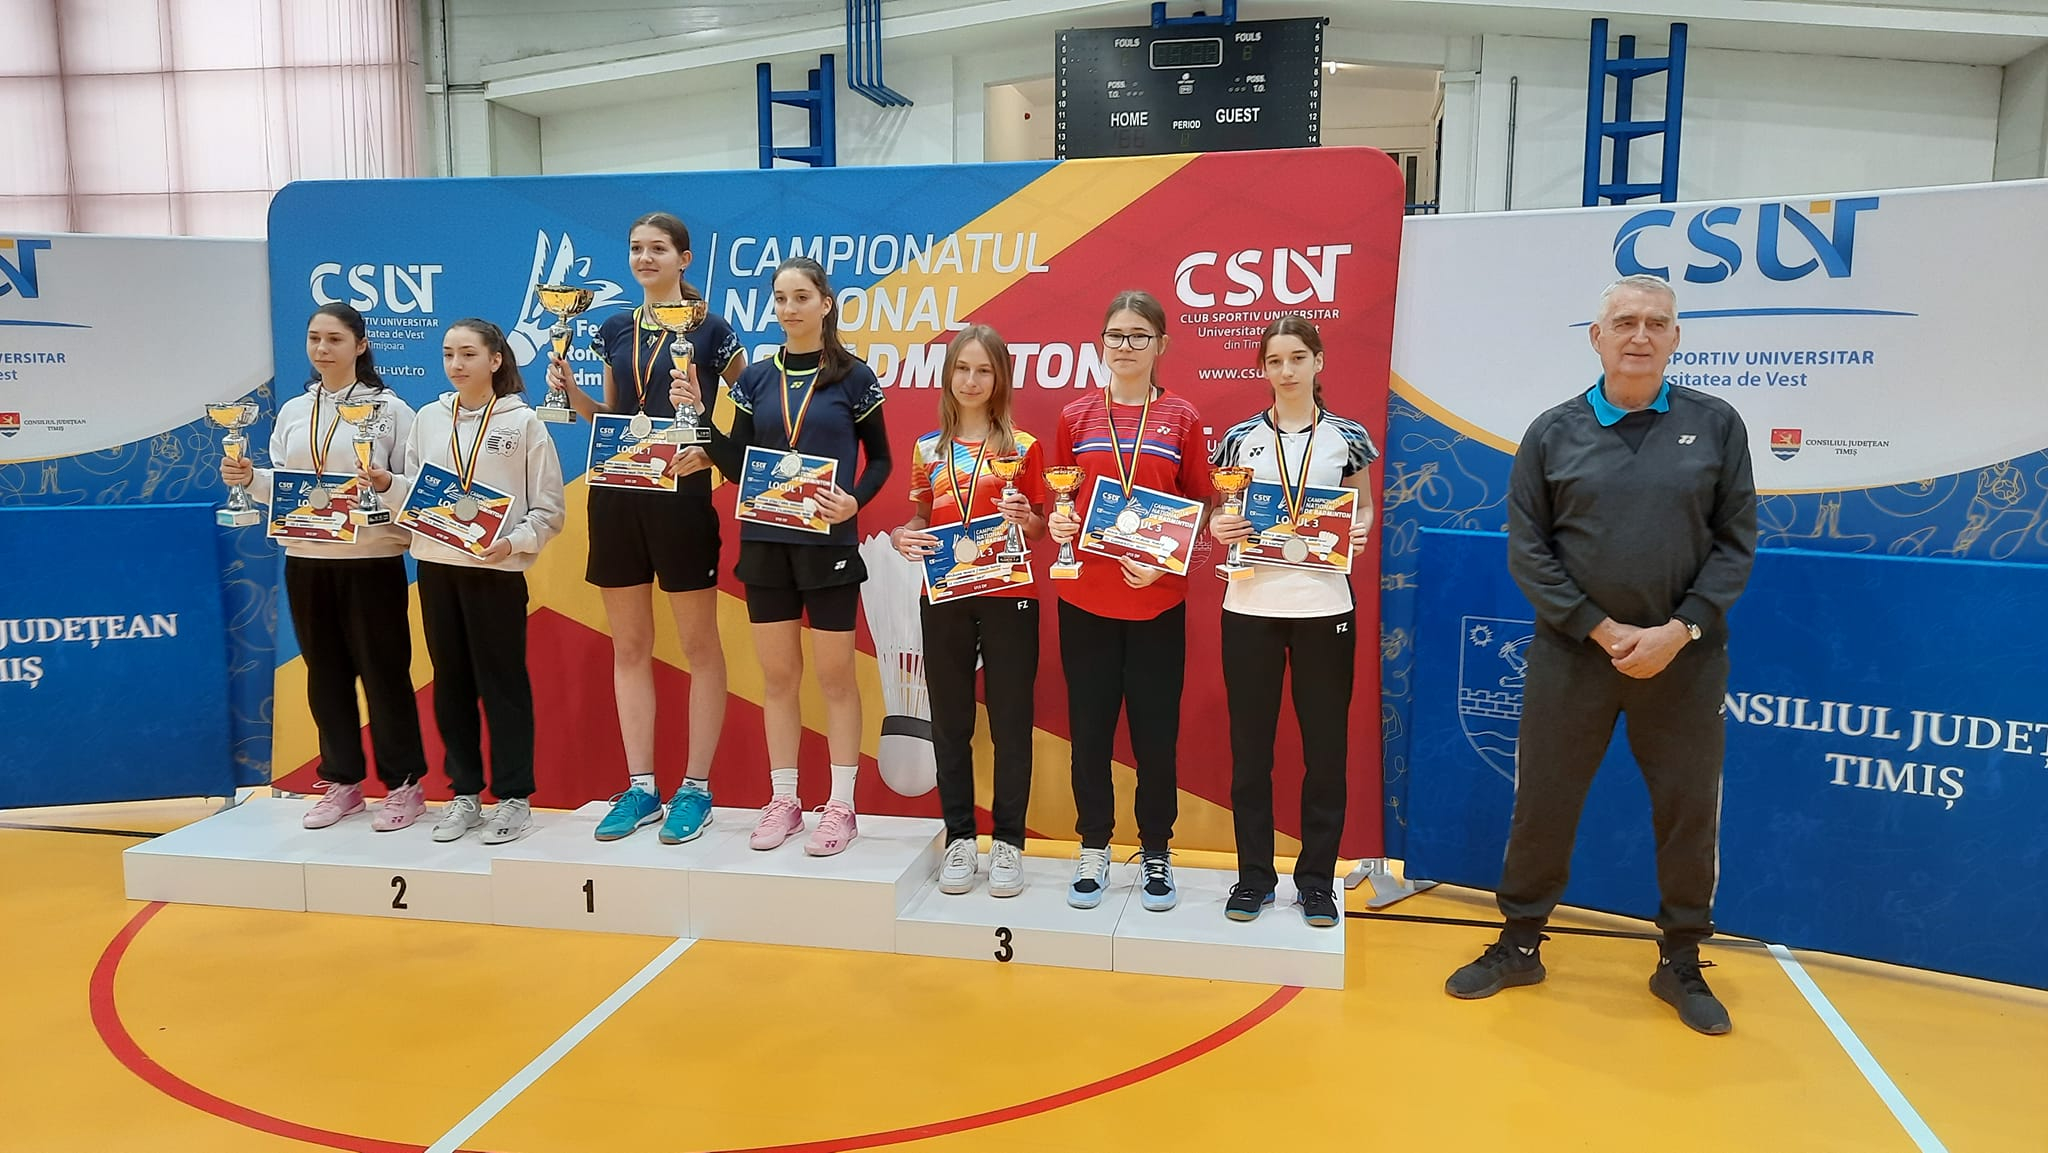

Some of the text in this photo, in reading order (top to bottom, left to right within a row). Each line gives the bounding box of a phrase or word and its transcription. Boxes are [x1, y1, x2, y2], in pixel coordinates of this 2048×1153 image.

[1234, 32, 1262, 42] FOULS
[1114, 38, 1140, 48] FOULS
[1314, 68, 1318, 76] 8
[1062, 90, 1066, 98] 9
[1110, 112, 1148, 127] HOME
[1215, 107, 1260, 123] GUEST
[1308, 113, 1317, 121] 12
[1058, 122, 1066, 130] 12
[1173, 120, 1200, 130] PERIOD
[1308, 124, 1317, 132] 13
[728, 232, 1050, 277] CAMPIONATUL
[380, 317, 439, 328] UNIVERSITAR
[1180, 312, 1209, 324] CLUB
[1212, 311, 1262, 323] SPORTIV
[392, 329, 404, 339] de
[404, 330, 425, 339] Vest
[1198, 324, 1267, 338] Universitate
[1224, 340, 1240, 350] din
[1745, 350, 1875, 366] UNIVERSITAR
[1737, 371, 1762, 387] de
[1766, 371, 1808, 387] Vest
[379, 423, 386, 433] 6
[505, 440, 512, 450] 6
[1805, 439, 1848, 447] CONSILIUL
[616, 444, 644, 455] LOCUL
[768, 480, 796, 494] LOCUL
[1276, 515, 1312, 527] LOUL
[1155, 524, 1162, 533] 3
[988, 548, 994, 556] 3
[1017, 600, 1028, 610] FZ
[1336, 622, 1348, 634] FZ
[1724, 692, 1901, 741] NSILIUL
[1824, 752, 1965, 810] TIMIȘ
[390, 876, 408, 910] 2
[582, 879, 596, 913] 1
[994, 926, 1014, 964] 3
